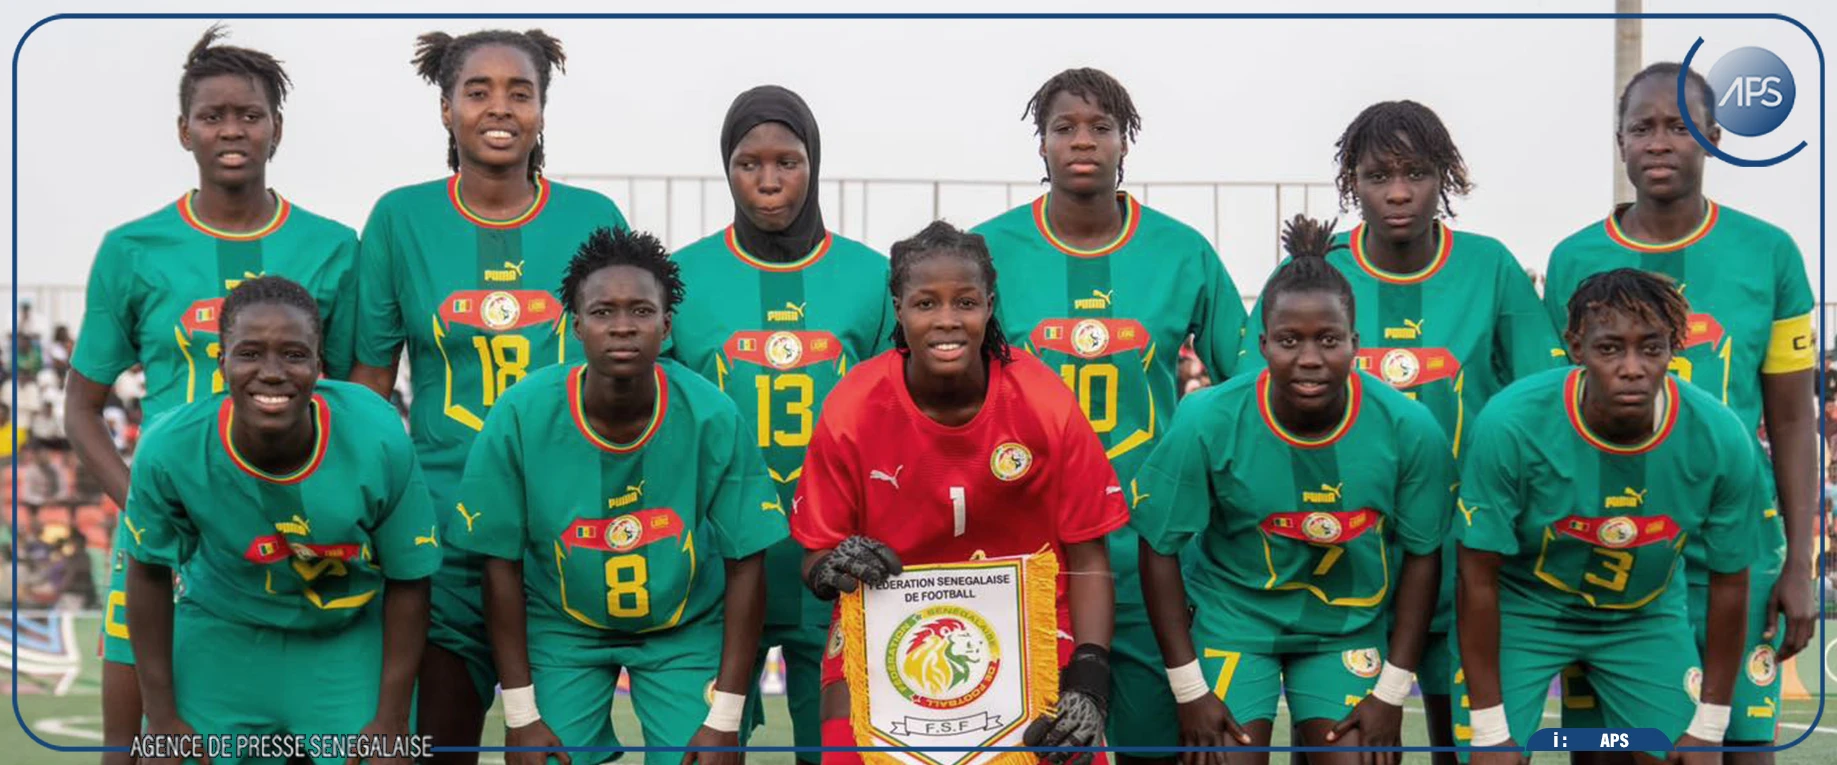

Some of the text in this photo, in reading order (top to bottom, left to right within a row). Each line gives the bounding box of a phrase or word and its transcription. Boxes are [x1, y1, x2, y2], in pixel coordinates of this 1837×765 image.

[473, 335, 530, 406] 18
[755, 373, 813, 447] 13
[949, 486, 967, 538] 1
[937, 574, 1011, 587] SENEGALAISE
[1308, 543, 1345, 575] 7
[1585, 548, 1633, 591] 3
[605, 554, 650, 618] 8
[905, 589, 976, 602] DE FOOTBALL
[1204, 648, 1241, 701] 7
[925, 720, 968, 733] F.S.F
